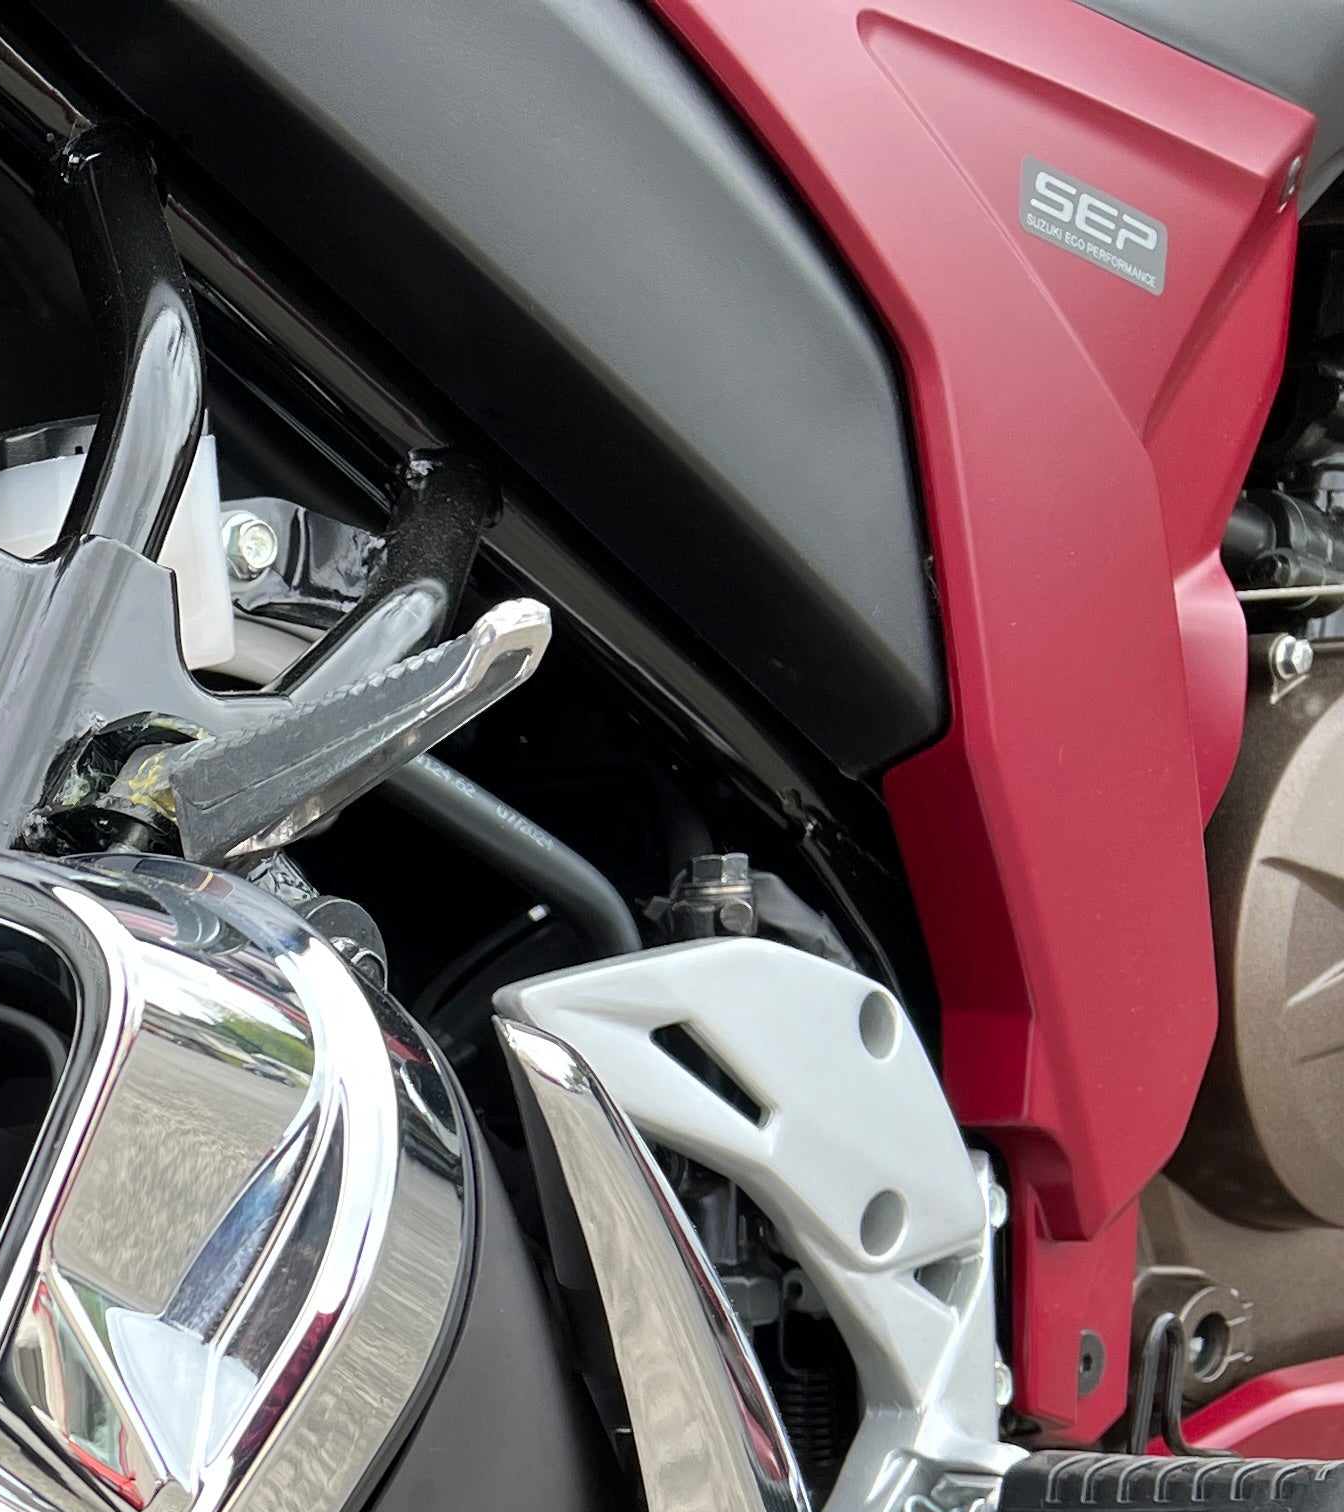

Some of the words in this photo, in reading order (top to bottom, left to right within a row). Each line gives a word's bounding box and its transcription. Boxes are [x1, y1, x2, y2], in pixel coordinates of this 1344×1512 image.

[1030, 170, 1158, 251] SEP
[1026, 212, 1062, 241] SUZUKI
[1064, 231, 1086, 252] ECO
[1086, 242, 1157, 288] PERFORMANCE
